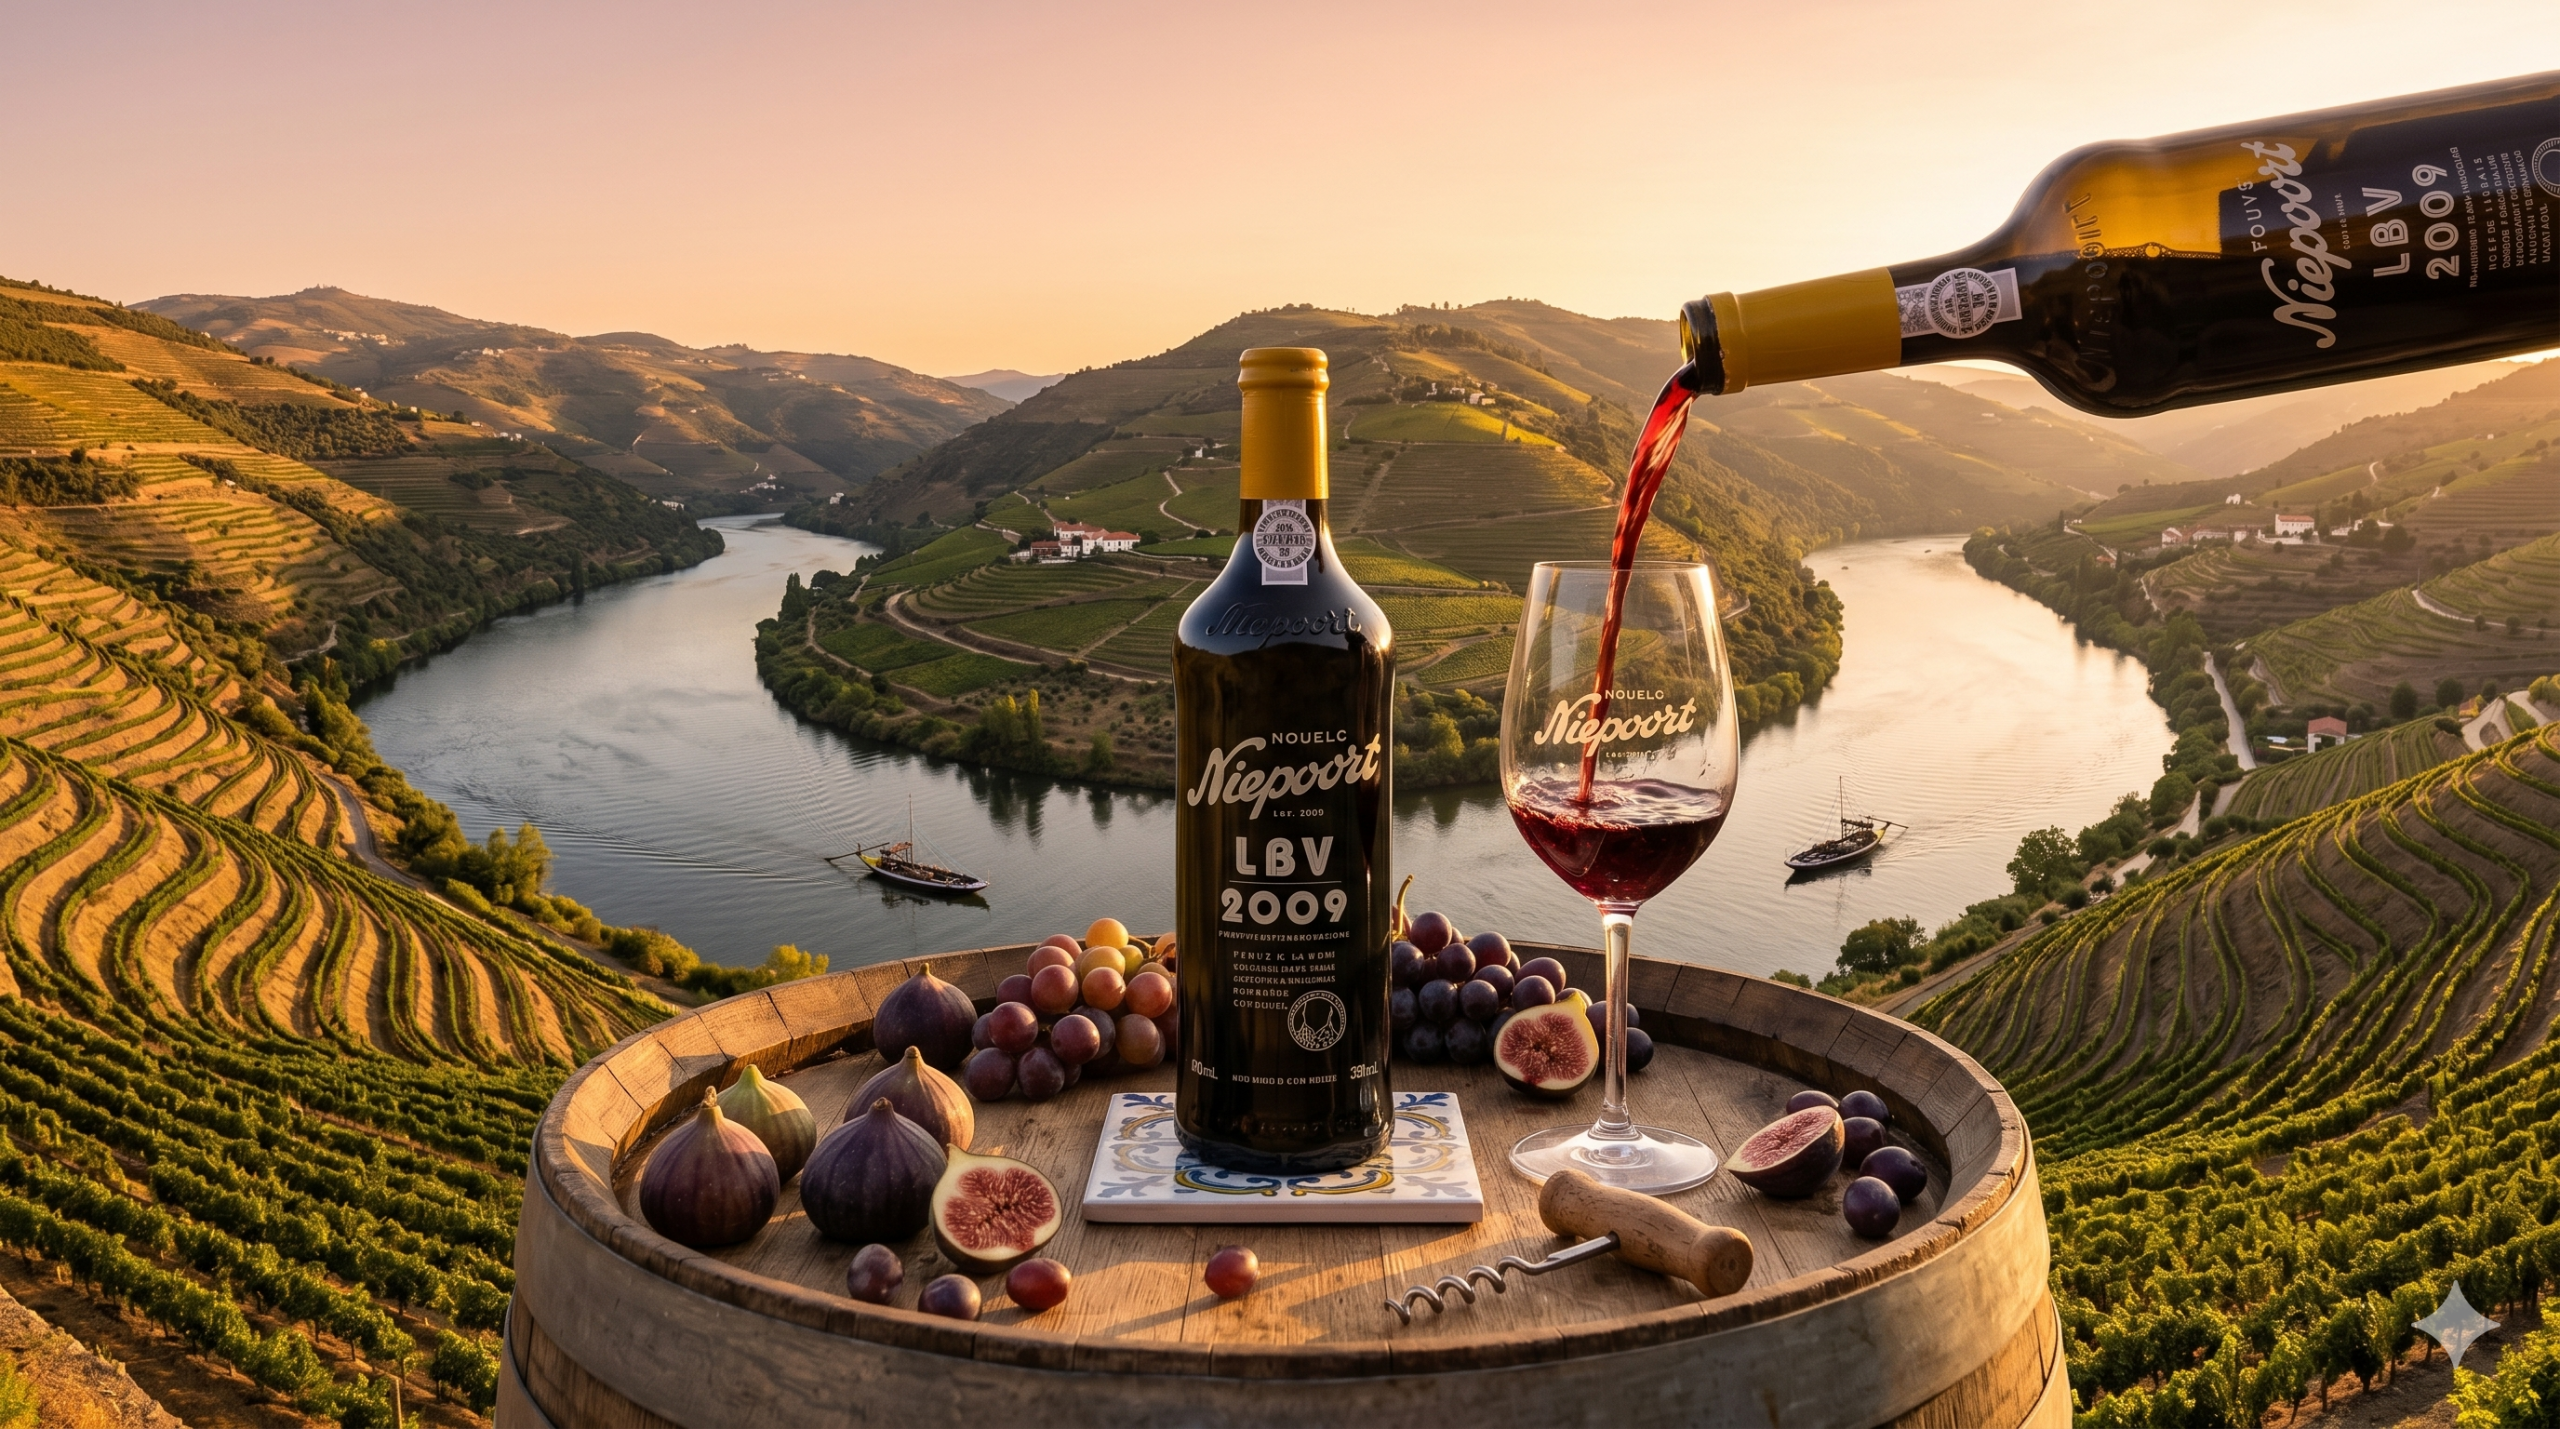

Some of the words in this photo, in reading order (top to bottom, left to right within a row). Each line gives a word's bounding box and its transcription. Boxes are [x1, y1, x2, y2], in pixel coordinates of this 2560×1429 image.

[2240, 141, 2352, 348] Niepoort
[2361, 187, 2410, 278] LBV
[2412, 164, 2459, 279] 2009
[1534, 693, 1696, 757] Niepoort
[1187, 733, 1381, 820] Niepoort
[1236, 836, 1334, 877] LBV
[1221, 888, 1347, 925] 2009
